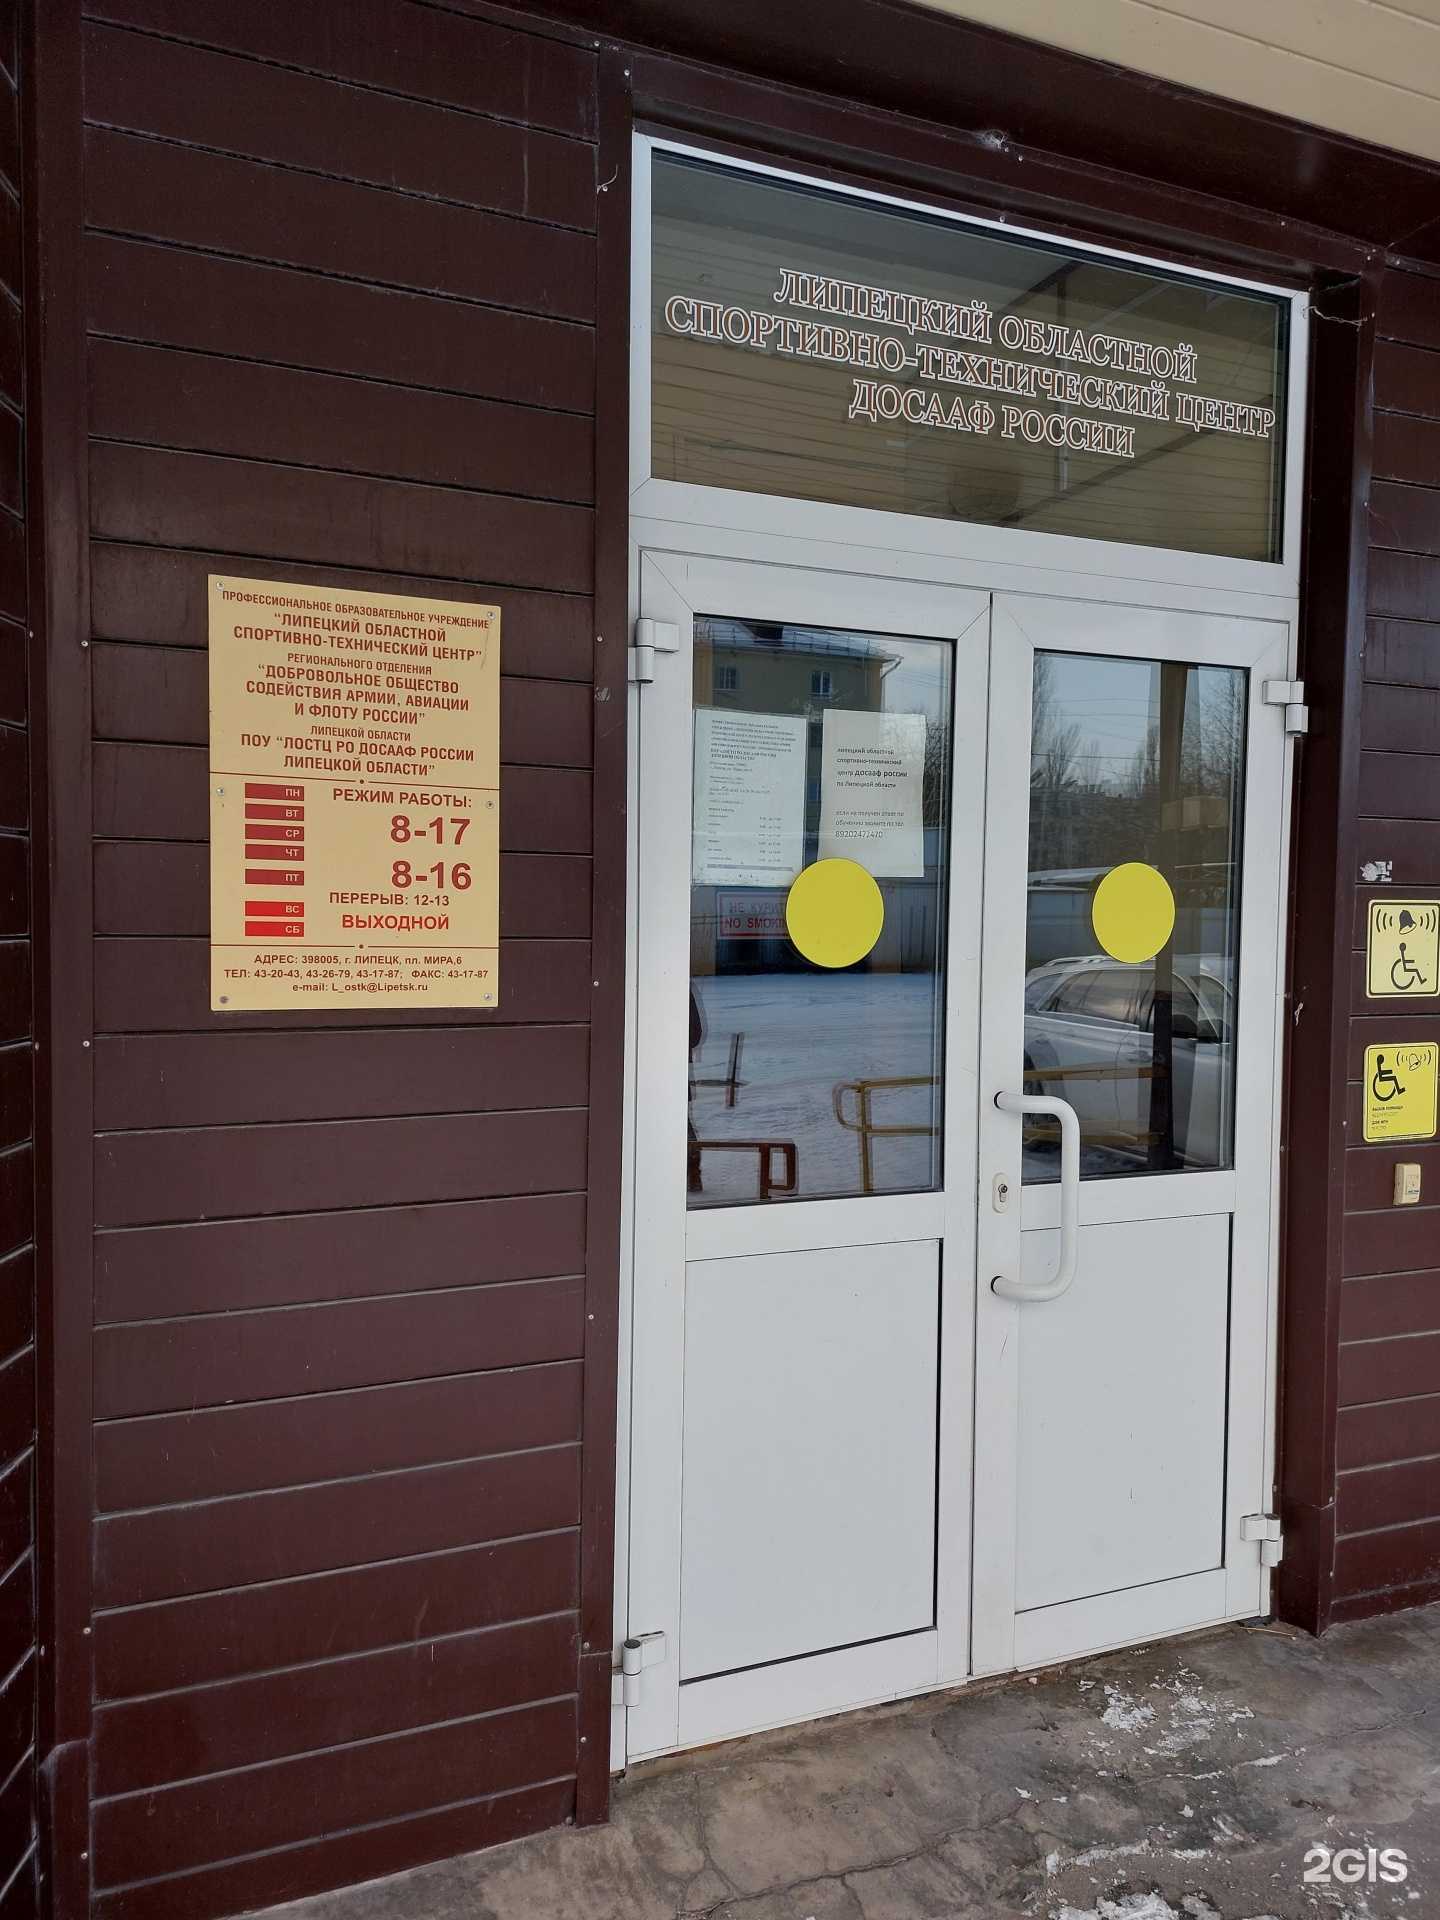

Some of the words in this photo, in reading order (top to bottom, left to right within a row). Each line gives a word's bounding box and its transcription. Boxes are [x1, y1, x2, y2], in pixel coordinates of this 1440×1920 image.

[773, 268, 992, 344] ЛИПЕЦКИЙ
[999, 315, 1198, 384] ОБЛАСТНОЙ
[665, 295, 1170, 421] СПОРТИВНО-ТЕХНИЧЕСКИЙ
[1175, 392, 1276, 438] ЦЕНТР
[849, 379, 995, 434] ДОСААФ
[1001, 405, 1135, 458] РОССИИ
[222, 590, 332, 612] ПРОФЕССИОНАЛЬНОЕ
[335, 603, 425, 622] ОБРАЗОВАТЕЛЬНОЕ
[428, 614, 489, 629] УЧРЕЖДЕНИЕ
[365, 622, 446, 642] ОБЛАСТНОЙ
[234, 626, 428, 657] СПОРТИВНО-ТЕХНИЧЕСКИЙ
[287, 653, 373, 669] РЕГИОНАЛЬНОГО
[376, 661, 432, 675] ОТДЕЛЕНИЯ
[386, 676, 459, 694] ОБЩЕСТВО
[246, 680, 341, 700] СОДЕЙСТВИЯ
[346, 690, 401, 706] АРМИИ,
[405, 695, 469, 711] АВИАЦИИ
[294, 702, 304, 716] И
[309, 703, 358, 720] ФЛОТУ
[311, 725, 365, 739] ЛИПЕЦКОЙ
[367, 729, 411, 742] ОБЛАСТИ
[241, 733, 271, 747] ПОУ
[336, 740, 355, 754] РО
[359, 742, 417, 758] ДОСААФ
[420, 746, 474, 762] РОССИИ
[284, 755, 361, 772] ЛИПЕЦКОЙ
[285, 788, 300, 798] ПН
[333, 788, 394, 804] РЕЖИМ
[399, 792, 472, 808] РАБОТЫ:
[285, 808, 299, 818] ВТ
[285, 829, 300, 838] СР
[390, 815, 471, 845] 8-17
[285, 848, 299, 858] ЧТ
[285, 873, 299, 882] ПТ
[391, 860, 472, 890] 8-16
[329, 892, 408, 906] ПЕРЕРЫВ:
[413, 894, 450, 907] 12-13
[285, 905, 299, 914] ВС
[285, 925, 300, 934] СБ
[342, 913, 449, 931] ВЫХОДНОЙ
[725, 917, 741, 929] NO
[747, 917, 787, 929] SMOKIN
[254, 955, 297, 965] АДРЕС:
[302, 955, 341, 966] 398005,
[354, 955, 402, 966] ЛИПЕЦК,
[405, 956, 421, 965] пл.
[224, 969, 251, 978] ТЕЛ:
[254, 969, 303, 980] 43-20-43,
[411, 970, 445, 979] ФАКС:
[447, 970, 489, 979] 43-17-87
[292, 983, 329, 992] e-mail:
